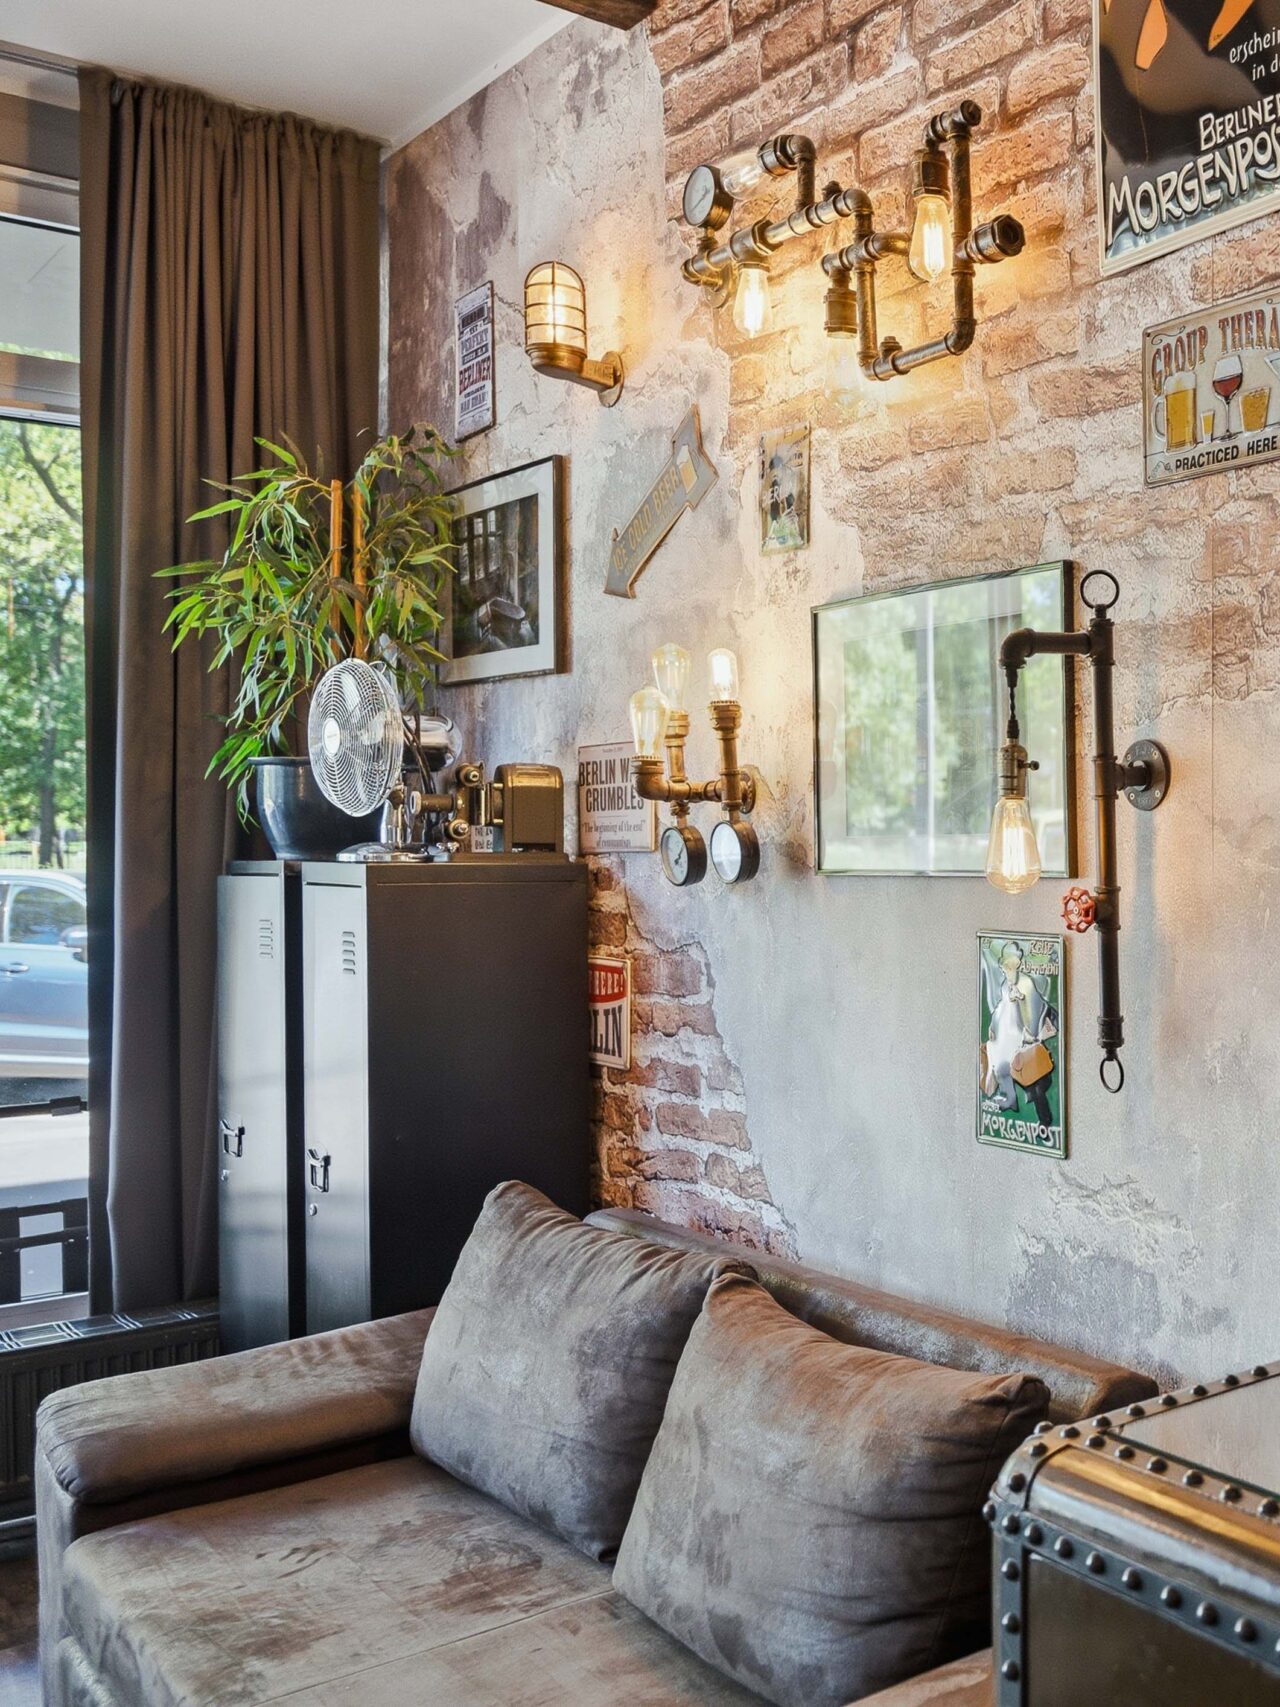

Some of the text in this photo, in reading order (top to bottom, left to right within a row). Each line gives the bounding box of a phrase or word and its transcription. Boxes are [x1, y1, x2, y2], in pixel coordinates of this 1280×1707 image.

[1252, 64, 1266, 81] in
[459, 355, 491, 396] BERLINER
[1151, 325, 1208, 397] GROUP
[1175, 436, 1278, 473] PRACTICED HERE
[629, 504, 651, 550] COLD
[652, 464, 681, 513] BEER
[578, 759, 616, 787] BERLIN
[590, 1004, 622, 1058] LIN
[981, 1111, 1062, 1149] MORGENPOST
